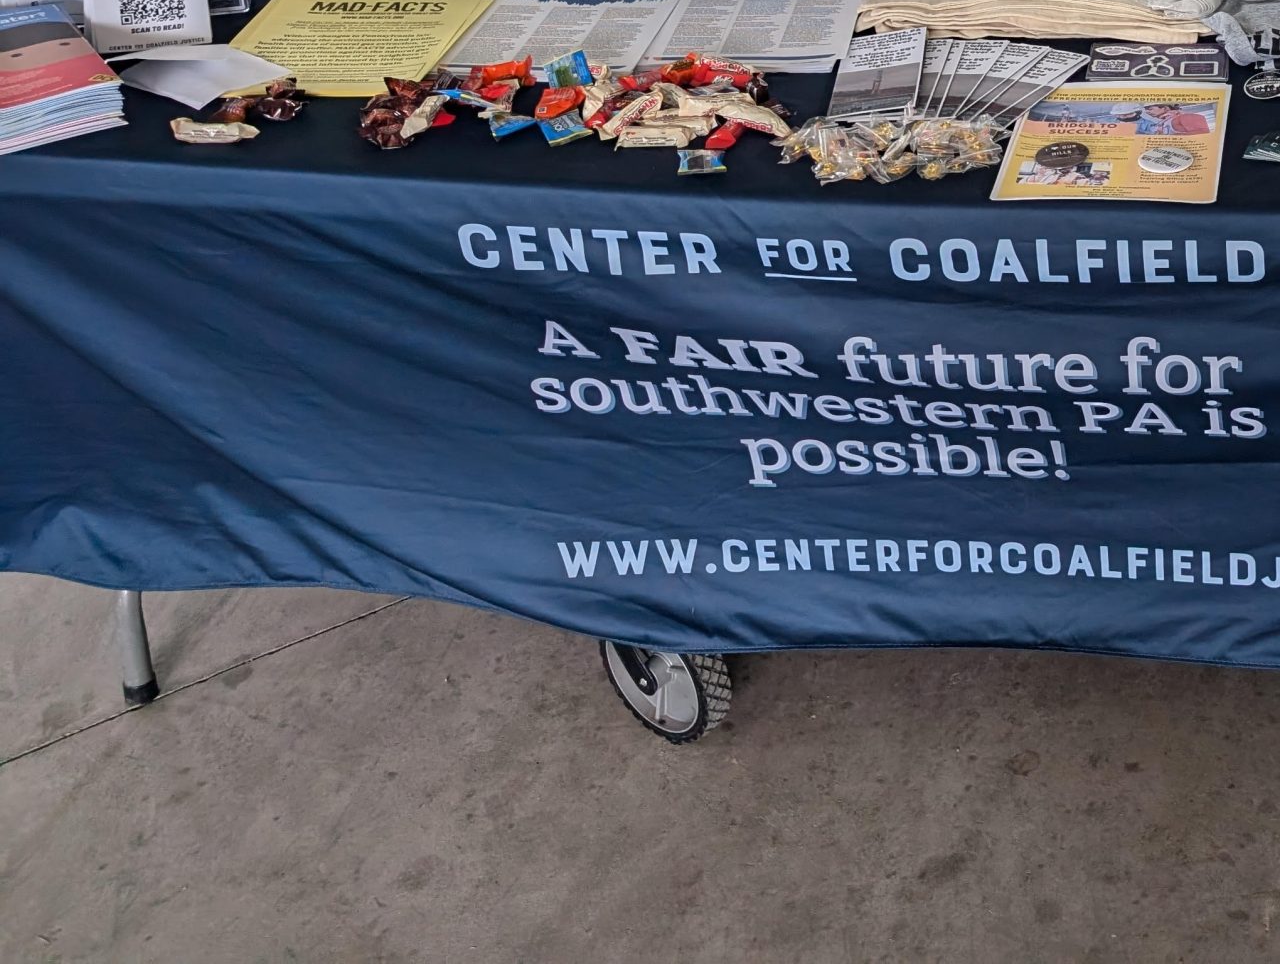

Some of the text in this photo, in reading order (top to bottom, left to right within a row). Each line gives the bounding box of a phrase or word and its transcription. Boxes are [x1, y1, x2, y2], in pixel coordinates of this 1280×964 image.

[310, 2, 447, 12] MAD-FACTS
[458, 223, 722, 276] CENTER
[756, 237, 852, 272] FOR
[889, 237, 1267, 284] COALFIELD
[538, 320, 1243, 395] A FAIR future for
[530, 375, 1268, 439] southwestern PA is
[740, 434, 1071, 488] possible!
